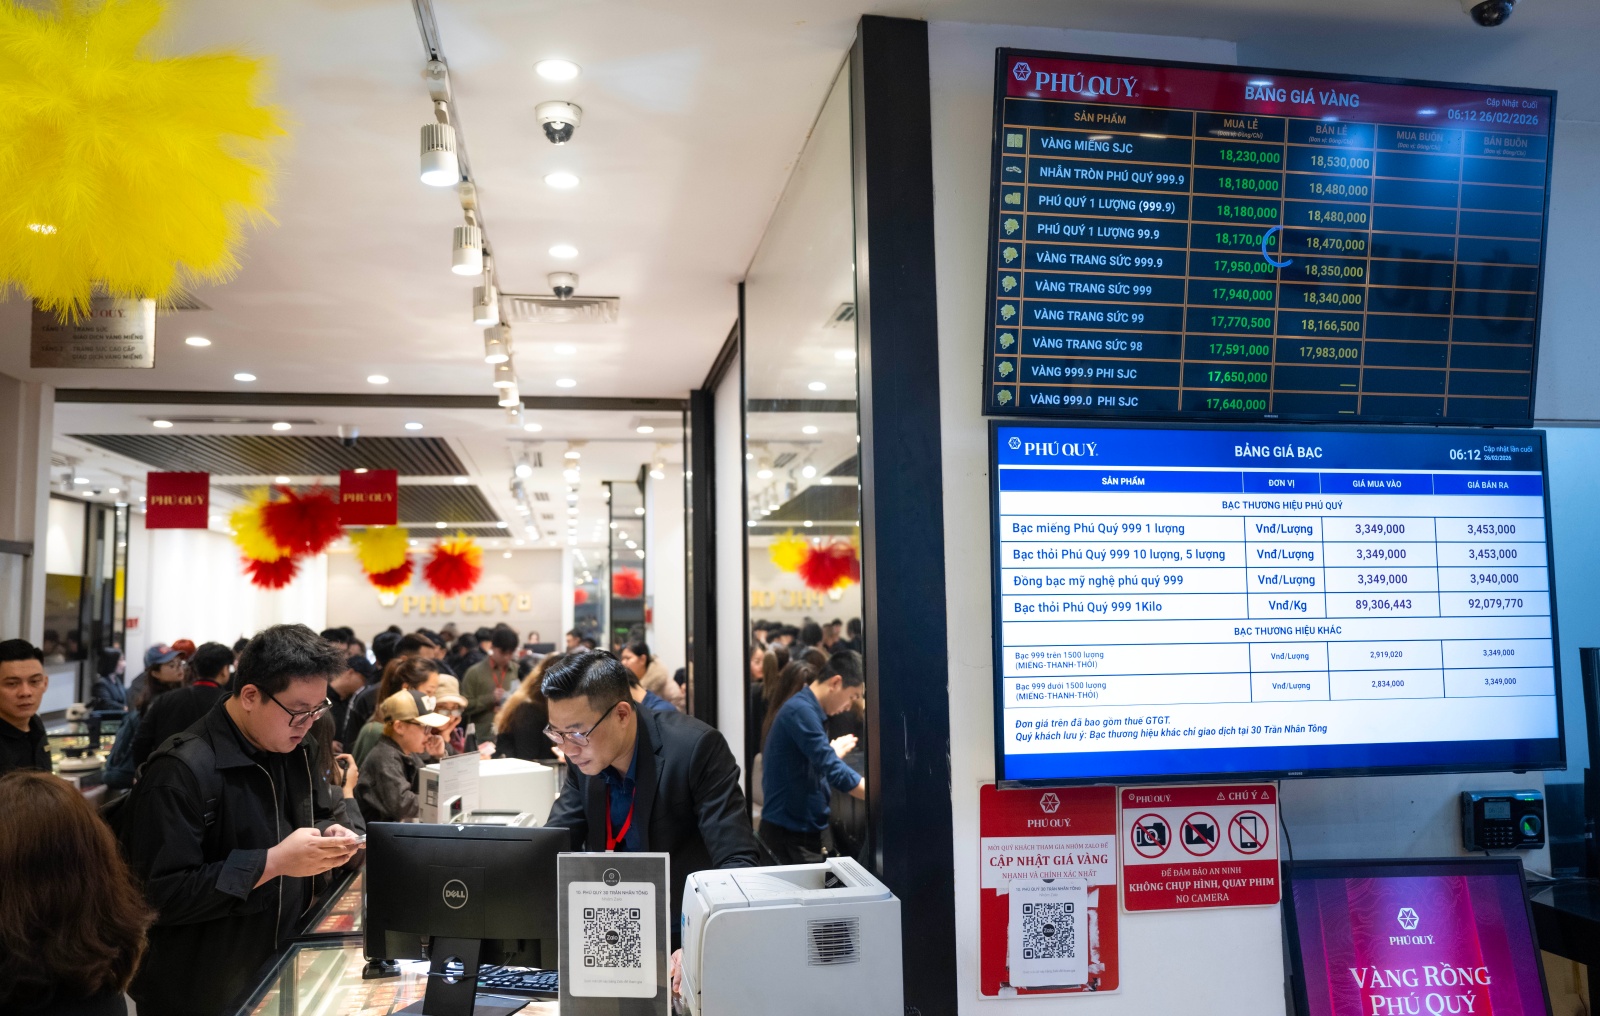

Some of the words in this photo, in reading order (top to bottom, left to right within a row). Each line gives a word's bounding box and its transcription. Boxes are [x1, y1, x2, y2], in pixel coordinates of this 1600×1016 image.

[1035, 70, 1084, 92] PHÚ
[1088, 76, 1138, 97] QUÝ
[1291, 88, 1315, 104] GIÁ
[1319, 91, 1359, 108] VÀNG
[1448, 109, 1477, 121] 06:12
[1480, 111, 1538, 125] 26/02/2026
[1224, 119, 1245, 129] MUA
[1041, 137, 1072, 150] VÀNG
[1112, 142, 1133, 154] SJC
[1220, 150, 1280, 164] 18,230,000
[1311, 156, 1369, 169] 18,530,000
[1074, 168, 1104, 180] TRÒN
[1107, 168, 1128, 182] PHÚ
[1132, 170, 1154, 184] QUÝ
[1156, 174, 1184, 185] 999.9
[1218, 177, 1279, 191] 18,180,000
[1310, 183, 1368, 196] 18,480,000
[1039, 194, 1061, 206] PHÚ
[1064, 195, 1086, 208] QUÝ
[1090, 199, 1094, 208] 1
[1099, 198, 1136, 212] LƯỢNG
[1139, 200, 1175, 214] (999.9)
[1217, 205, 1277, 219] 18,180,000
[1308, 210, 1366, 224] 18,480,000
[1306, 238, 1365, 251] 18,470,000
[1036, 251, 1066, 263] VÀNG
[1070, 254, 1106, 265] TRANG
[1109, 254, 1132, 266] SỨC
[1134, 257, 1163, 268] 999.9
[1214, 261, 1274, 273] 17,950,000
[1305, 265, 1363, 278] 18,350,000
[1213, 288, 1272, 301] 17,940,000
[1303, 292, 1361, 305] 18,340,000
[1211, 316, 1270, 329] 17,770,500
[1302, 320, 1359, 332] 18,166,500
[1033, 337, 1062, 348] VÀNG
[1066, 340, 1102, 350] TRANG
[1105, 339, 1127, 351] SỨC
[1130, 342, 1142, 351] 98
[1210, 344, 1269, 356] 17,591,000
[1300, 347, 1358, 359] 17,983,000
[1032, 365, 1062, 377] VÀNG
[1064, 368, 1093, 377] 999.9
[1096, 369, 1114, 378] PHI
[1117, 370, 1137, 379] SJC
[1208, 371, 1267, 383] 17,650,000
[1206, 399, 1266, 411] 17,640,000
[1024, 441, 1059, 456] PHÚ
[1062, 442, 1097, 457] QUÝ
[1235, 442, 1270, 457] BẢNG
[1273, 444, 1294, 457] GIÁ
[1298, 447, 1322, 459] BẠC
[1450, 449, 1481, 460] 06:12
[1102, 476, 1118, 485] SẢN
[1353, 479, 1365, 487] GIÁ
[1386, 479, 1401, 488] VÀO
[1468, 480, 1480, 488] GIÁ
[1482, 480, 1496, 488] BÁN
[1013, 523, 1033, 534] Bạc
[1074, 523, 1094, 533] Phú
[1098, 523, 1118, 535] Quý
[1122, 523, 1142, 533] 999
[1145, 524, 1150, 533] 1
[1155, 523, 1185, 535] lượng
[1256, 524, 1313, 536] Vnđ/Lượng
[1356, 524, 1405, 535] 3,349,000
[1468, 524, 1516, 535] 3,453,000
[1013, 549, 1033, 560] Bạc
[1037, 548, 1058, 559] thỏi
[1062, 549, 1083, 560] Phú
[1086, 550, 1106, 561] Quý
[1110, 550, 1130, 559] 999
[1134, 550, 1147, 559] 10
[1150, 549, 1182, 561] lượng,
[1186, 550, 1192, 559] 5
[1196, 550, 1225, 561] lượng
[1257, 549, 1314, 561] Vnđ/Lượng
[1356, 549, 1406, 560] 3,349,000
[1469, 549, 1517, 560] 3,453,000
[1046, 576, 1065, 587] bạc
[1069, 576, 1085, 587] mỹ
[1088, 575, 1115, 587] nghệ
[1118, 575, 1138, 586] phú
[1142, 575, 1160, 587] quý
[1163, 575, 1183, 585] 999
[1358, 574, 1407, 585] 3,349,000
[1470, 574, 1518, 584] 3,940,000
[1014, 603, 1035, 614] Bạc
[1038, 601, 1060, 613] thỏi
[1063, 602, 1084, 612] Phú
[1087, 602, 1108, 614] Quý
[1111, 602, 1132, 611] 999
[1135, 602, 1162, 612] 1Kilo
[1269, 600, 1307, 612] Vnđ/Kg
[1356, 600, 1412, 610] 89,306,443
[1469, 598, 1523, 610] 92,079,770
[1015, 652, 1029, 660] Bạc
[1370, 651, 1402, 659] 2,919,020
[1483, 649, 1514, 657] 3,349,000
[1372, 680, 1404, 688] 2,834,000
[1136, 795, 1152, 803] PHÚ
[1229, 791, 1248, 800] CHÚ
[1251, 790, 1257, 799] Ý
[1028, 819, 1047, 828] PHÚ
[1050, 818, 1070, 827] QUÝ
[990, 854, 1014, 868] CẬP
[1017, 854, 1050, 868] NHẬT
[1053, 853, 1074, 865] GIÁ
[1077, 852, 1108, 864] VÀNG
[1040, 870, 1061, 878] CHÍNH
[1129, 882, 1163, 892] KHÔNG
[1166, 881, 1191, 891] CHỤP
[1222, 879, 1247, 888] QUAY
[1250, 878, 1274, 886] PHIM
[446, 890, 465, 898] DELL
[1176, 895, 1189, 903] NO
[1192, 893, 1229, 902] CAMERA
[1390, 936, 1410, 945] PHÚ
[1413, 934, 1434, 944] QUÝ
[1349, 966, 1418, 988] VÀNG
[1422, 962, 1492, 986] RỒNG
[1369, 990, 1419, 1016] PHÚ
[1425, 990, 1476, 1016] QUÝ
